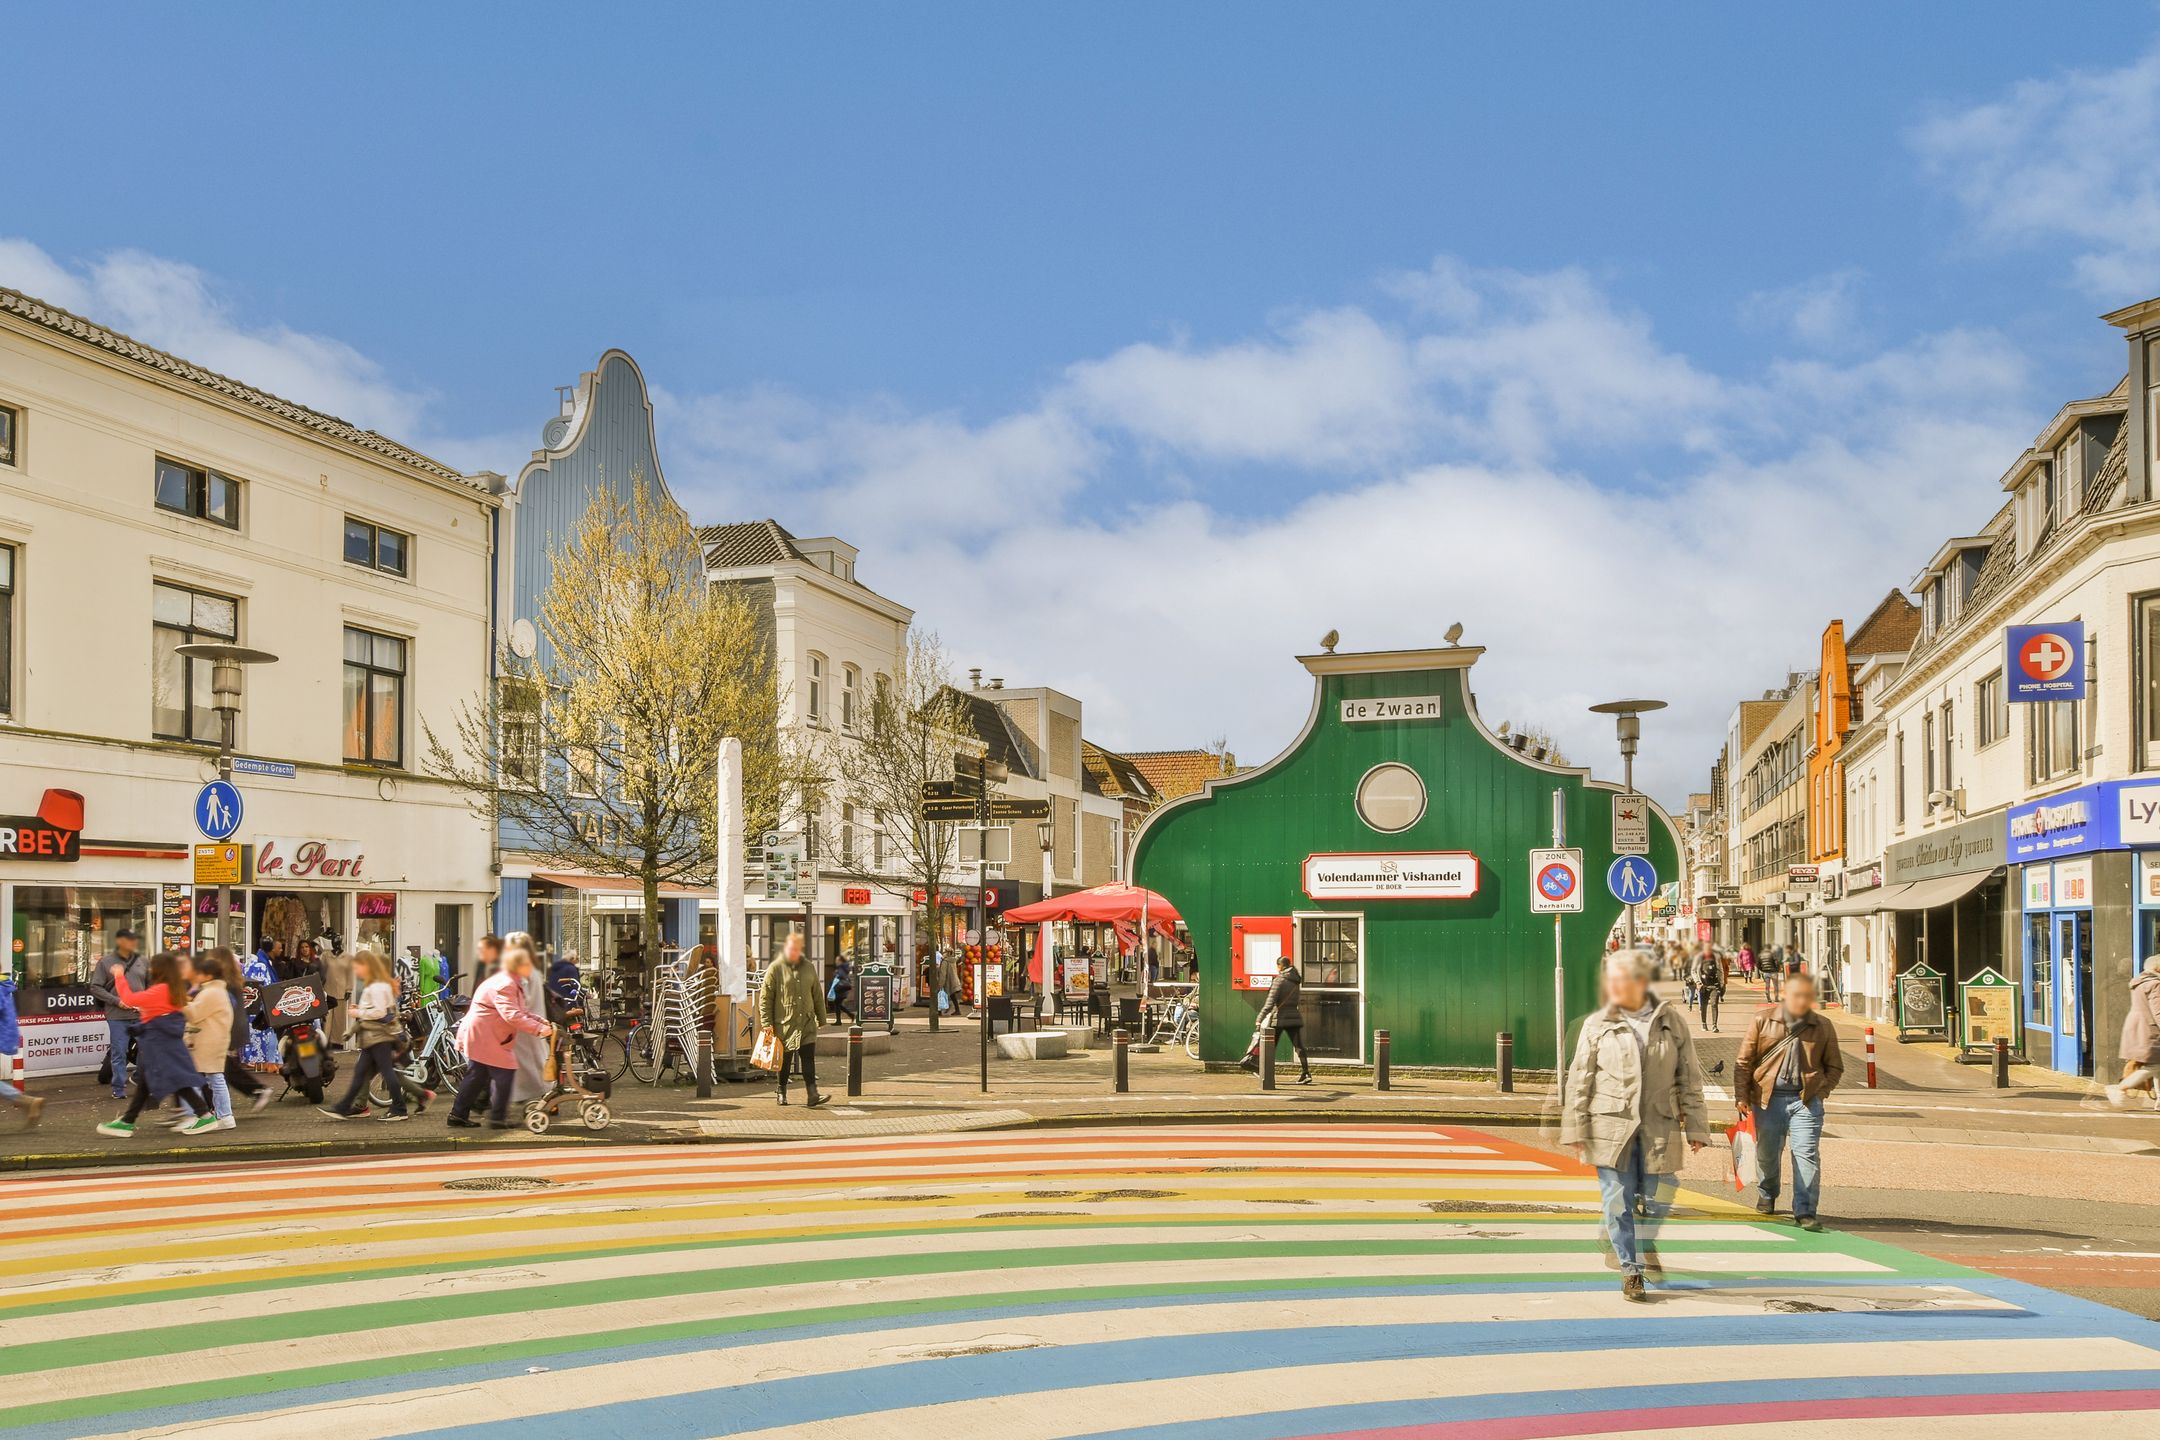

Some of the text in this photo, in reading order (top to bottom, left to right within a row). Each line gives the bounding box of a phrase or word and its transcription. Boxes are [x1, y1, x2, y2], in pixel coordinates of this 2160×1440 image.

[1345, 701, 1437, 719] de Zwaan
[234, 760, 294, 774] Gedempte Gracht
[2129, 798, 2160, 824] Ly
[1964, 837, 1994, 859] JUWELIER
[257, 841, 284, 874] le
[290, 841, 365, 877] Pari
[1317, 870, 1461, 883] Volendammer Vishandel
[360, 897, 392, 915] le Pari
[78, 1013, 106, 1021] SHOARMA
[28, 1033, 105, 1047] ENJOY THE BEST
[28, 1048, 61, 1058] DONER
[64, 1046, 74, 1055] IN
[76, 1045, 94, 1054] THE
